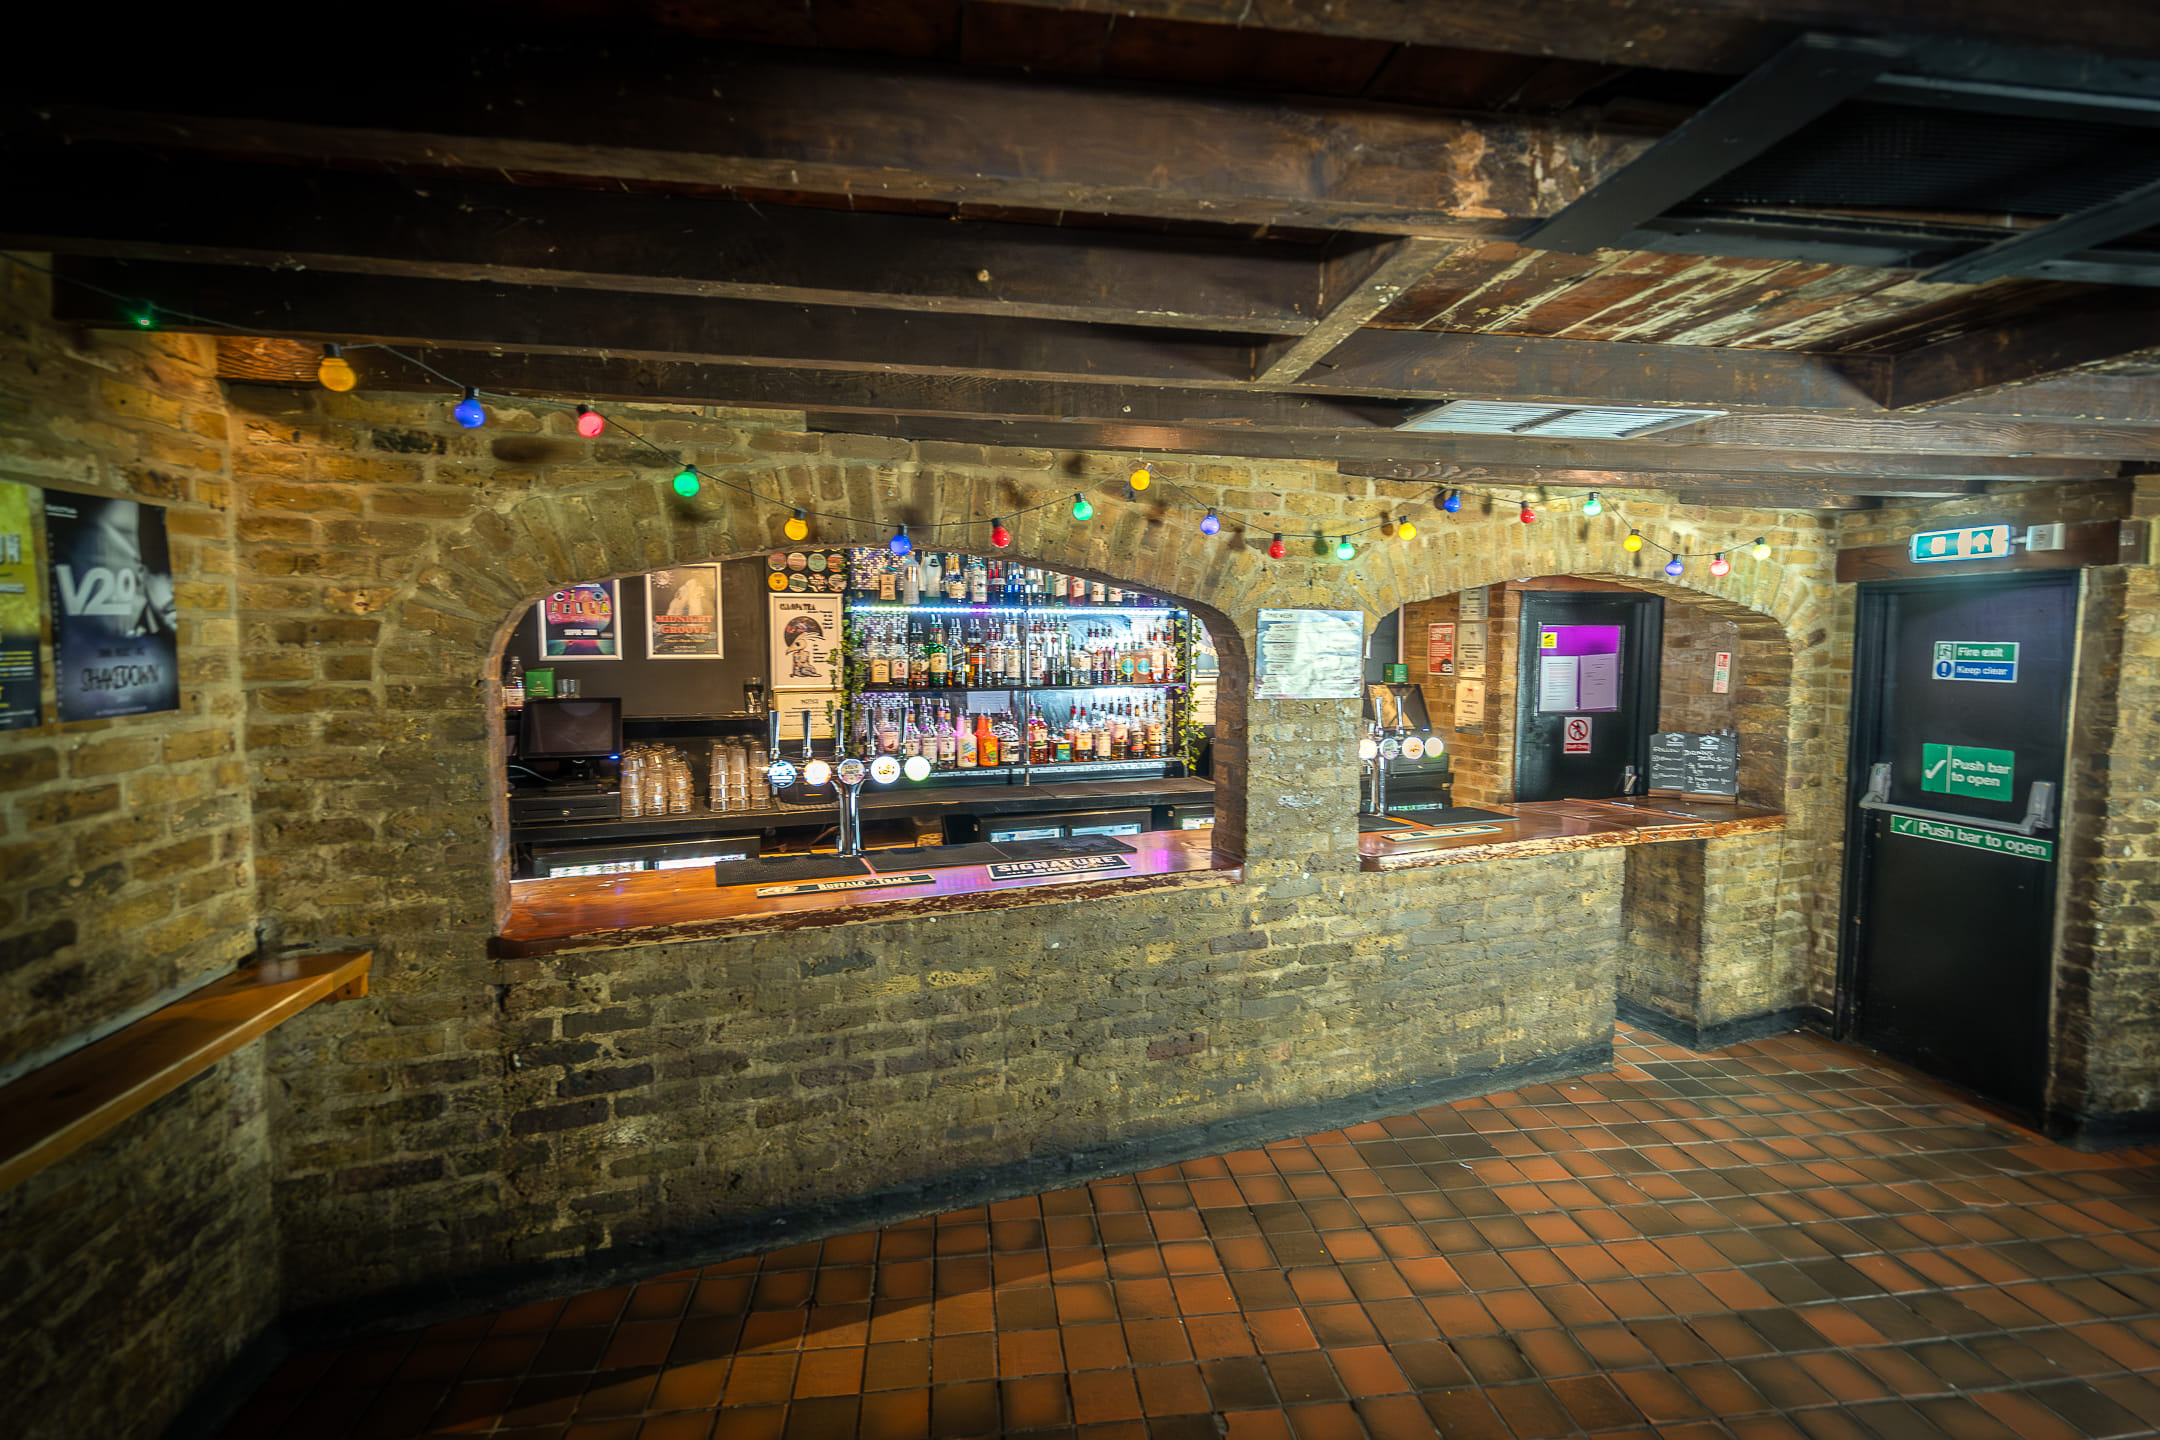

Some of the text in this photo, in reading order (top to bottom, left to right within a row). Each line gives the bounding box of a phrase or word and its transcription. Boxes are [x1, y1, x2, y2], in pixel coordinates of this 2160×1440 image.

[655, 615, 713, 623] MIDNIGHT
[661, 626, 709, 634] GROOVE
[1957, 647, 2004, 658] Fire exit
[1956, 666, 2008, 677] Keep clear
[1951, 758, 2012, 775] Push bar
[1951, 771, 2000, 787] to open
[1918, 822, 2047, 857] Push bar to open
[997, 856, 1117, 872] SIGNATURE
[818, 876, 911, 891] BUFFALO TRACE
